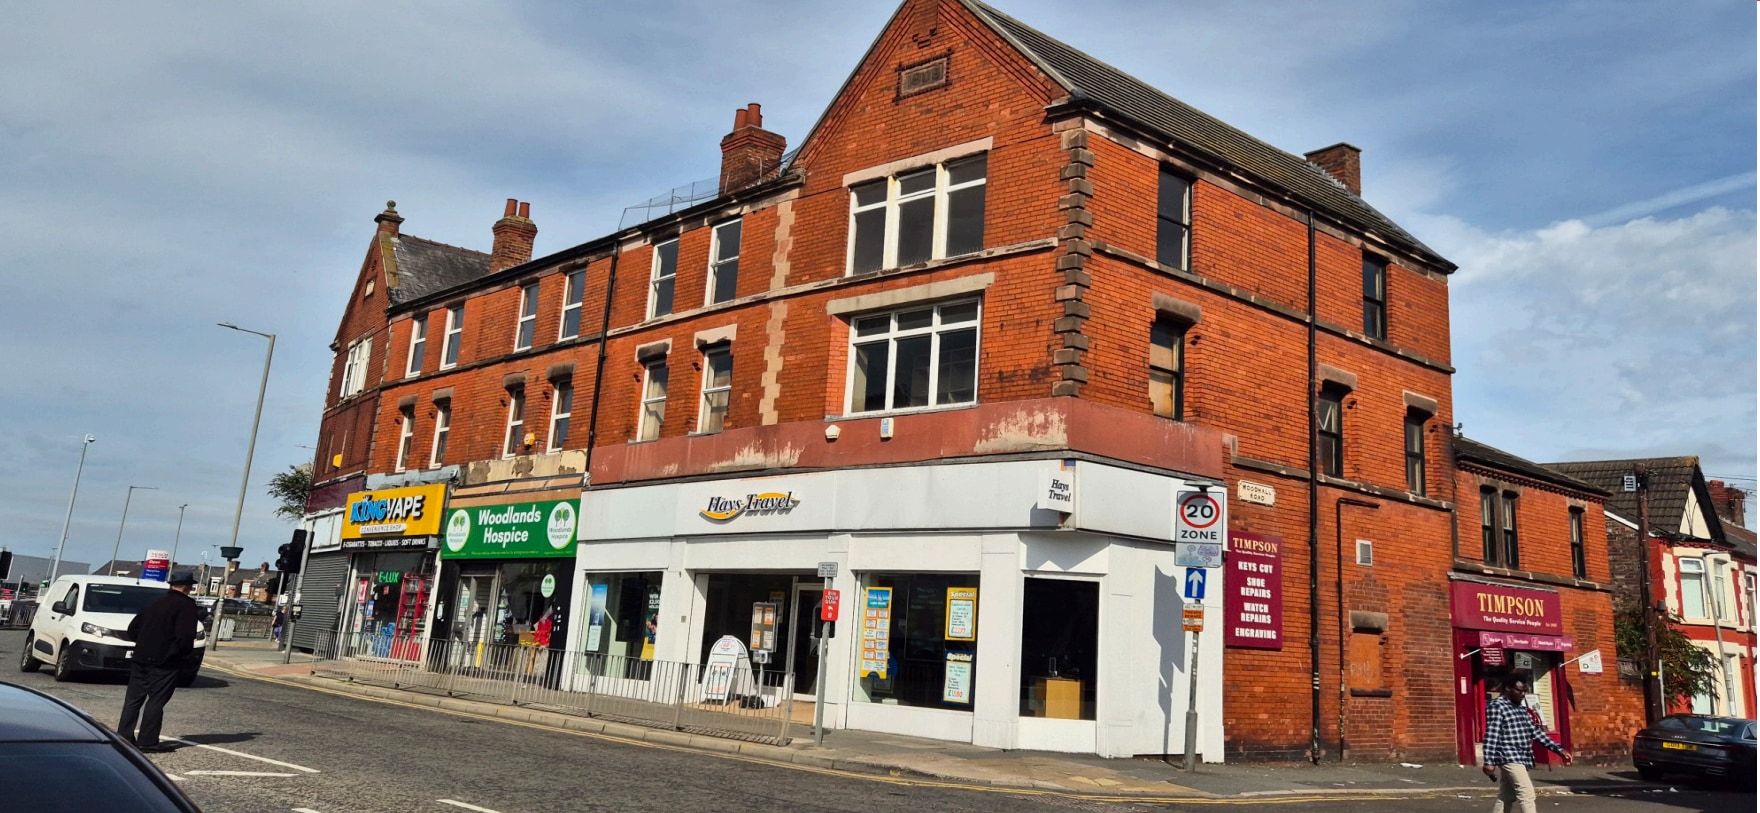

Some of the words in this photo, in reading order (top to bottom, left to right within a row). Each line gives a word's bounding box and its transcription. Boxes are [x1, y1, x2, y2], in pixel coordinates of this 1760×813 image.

[1051, 479, 1070, 493] Hays
[1242, 484, 1272, 496] WOODHALL
[1049, 489, 1072, 502] Travel
[1250, 492, 1265, 501] ROAD
[707, 496, 743, 515] Hays
[746, 491, 793, 510] Travel
[478, 504, 541, 526] Woodlands
[1186, 504, 1214, 519] 20
[483, 526, 529, 549] Hospice
[1181, 530, 1217, 540] ZONE
[1233, 537, 1278, 554] TIMPSON
[1238, 561, 1258, 572] KEYS
[1259, 563, 1274, 574] CUT
[378, 571, 400, 583] E-LUX
[1246, 576, 1266, 588] SHOE
[1240, 586, 1272, 600] REPAIRS
[1243, 602, 1269, 614] WATCH
[1477, 592, 1545, 618] TIMPSON
[1240, 612, 1272, 625] REPAIRS
[1492, 616, 1508, 625] Quality
[1235, 627, 1277, 640] ENGRAVING
